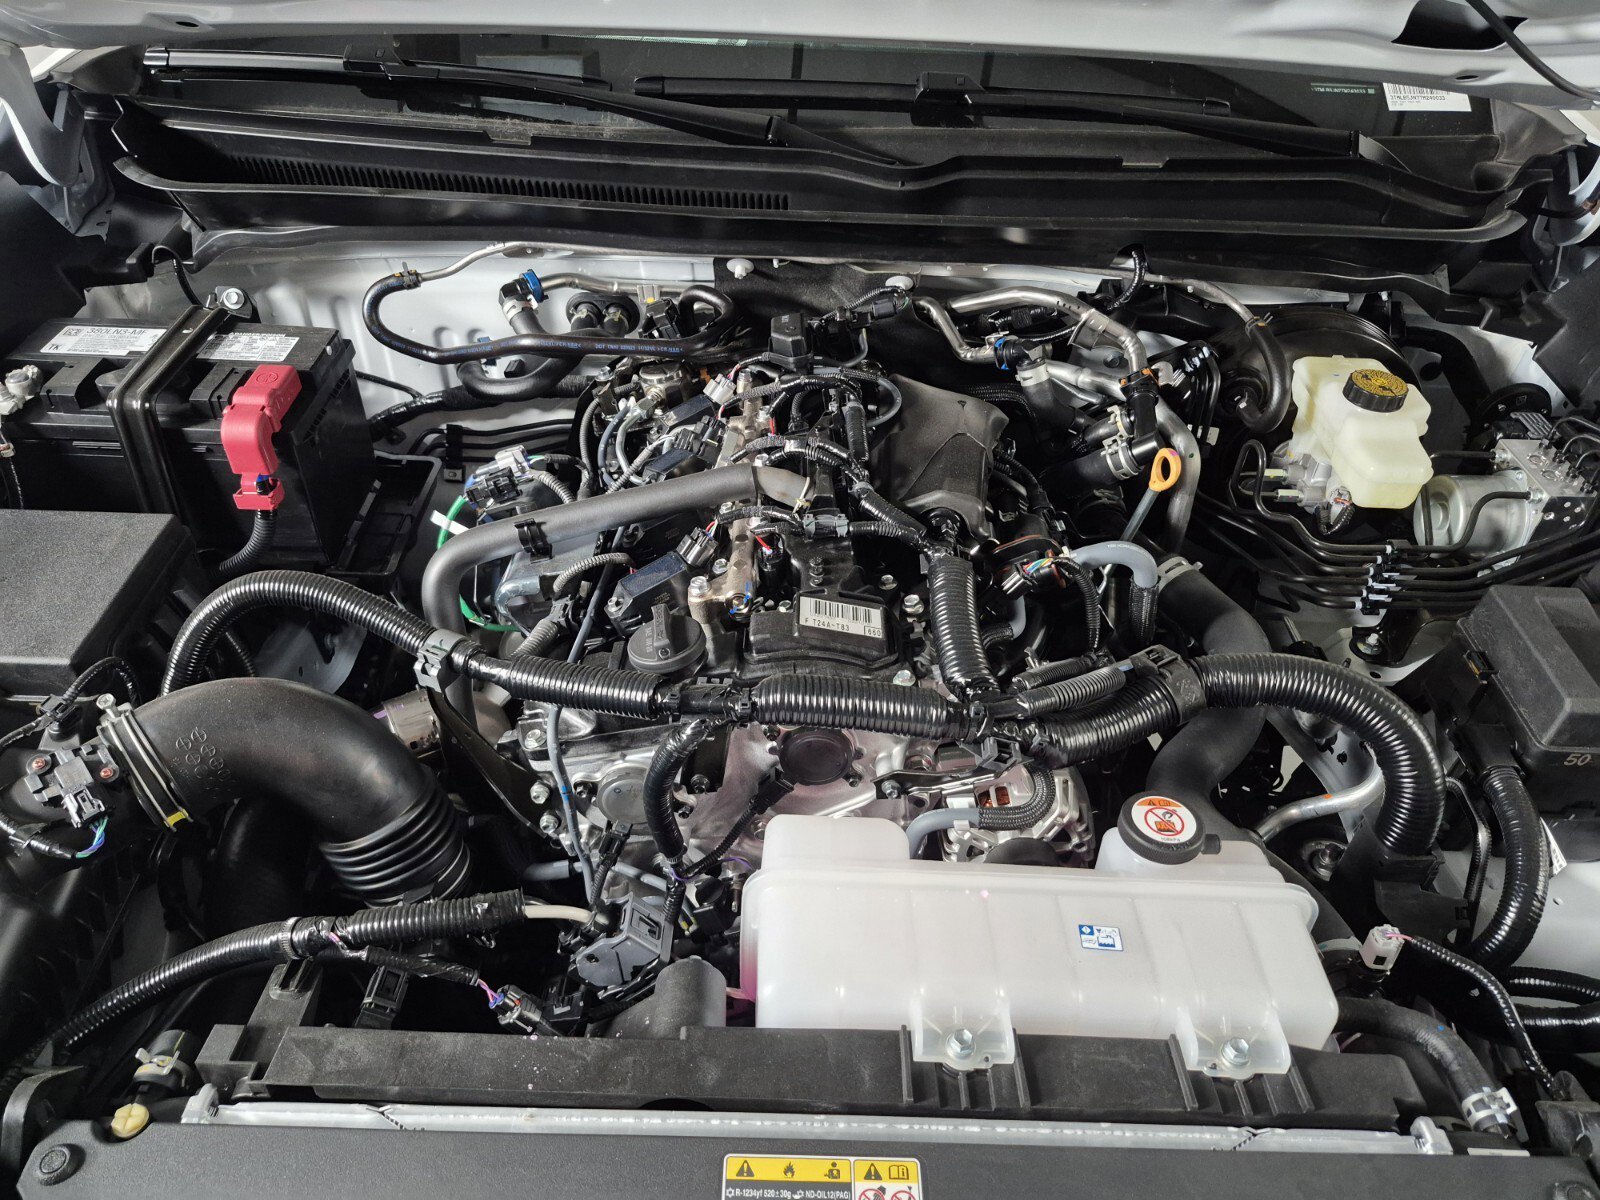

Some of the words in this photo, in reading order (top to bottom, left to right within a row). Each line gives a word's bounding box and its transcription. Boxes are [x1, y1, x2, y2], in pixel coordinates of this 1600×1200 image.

[812, 618, 850, 631] T24A-T83
[1563, 753, 1592, 766] 50
[735, 1188, 762, 1199] R-1234yf
[764, 1189, 792, 1199] 520±30g
[805, 1190, 851, 1200] ND-OIL12(PAG)
